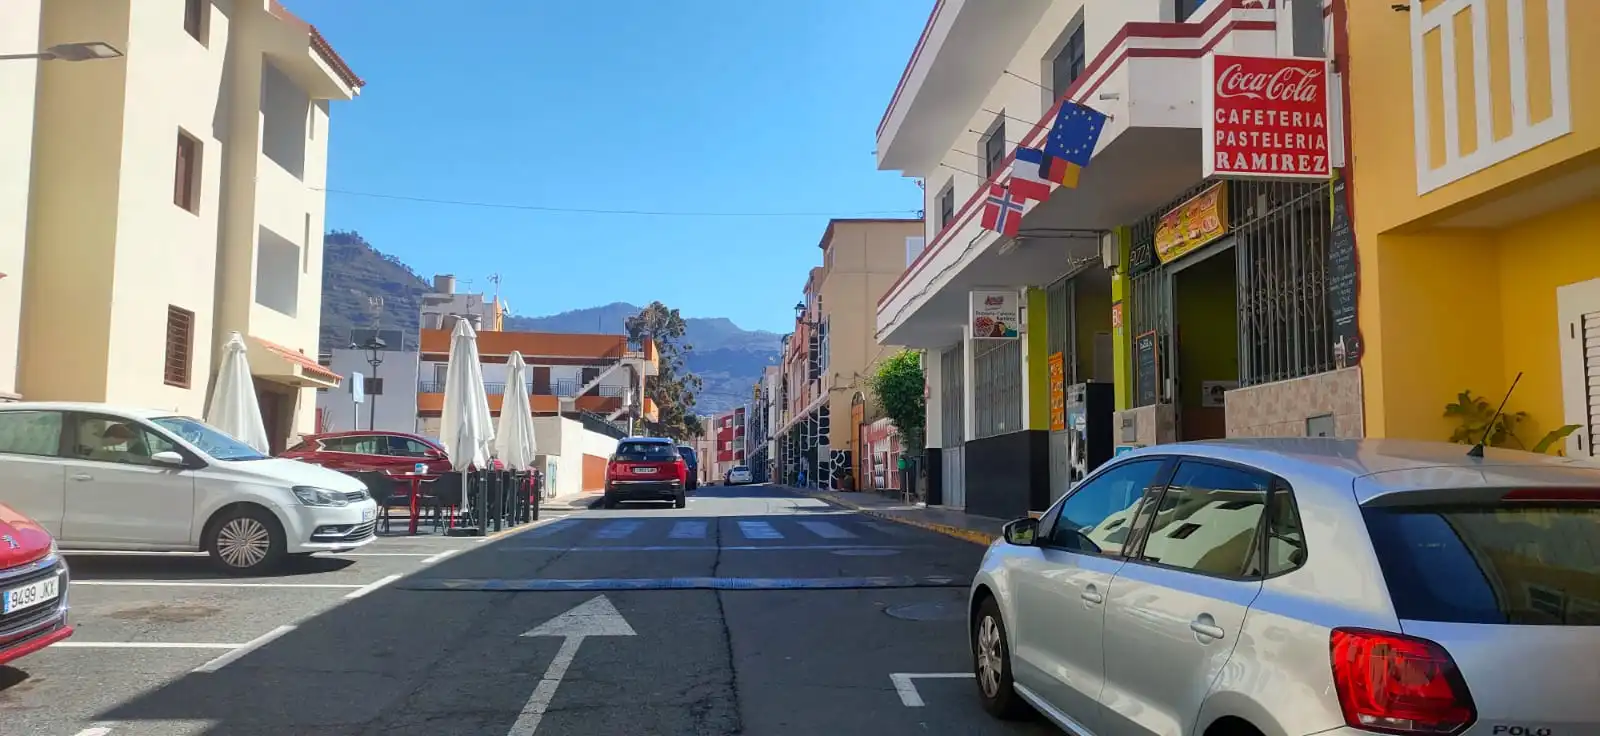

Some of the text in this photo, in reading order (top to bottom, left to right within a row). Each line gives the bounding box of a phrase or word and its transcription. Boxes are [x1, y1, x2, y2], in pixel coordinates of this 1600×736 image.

[1215, 108, 1324, 128] CAFETERIA
[1216, 130, 1326, 150] PASTELERIA
[1216, 151, 1327, 172] RAMIREZ
[11, 586, 36, 608] 9499
[1492, 725, 1552, 736] POLO
